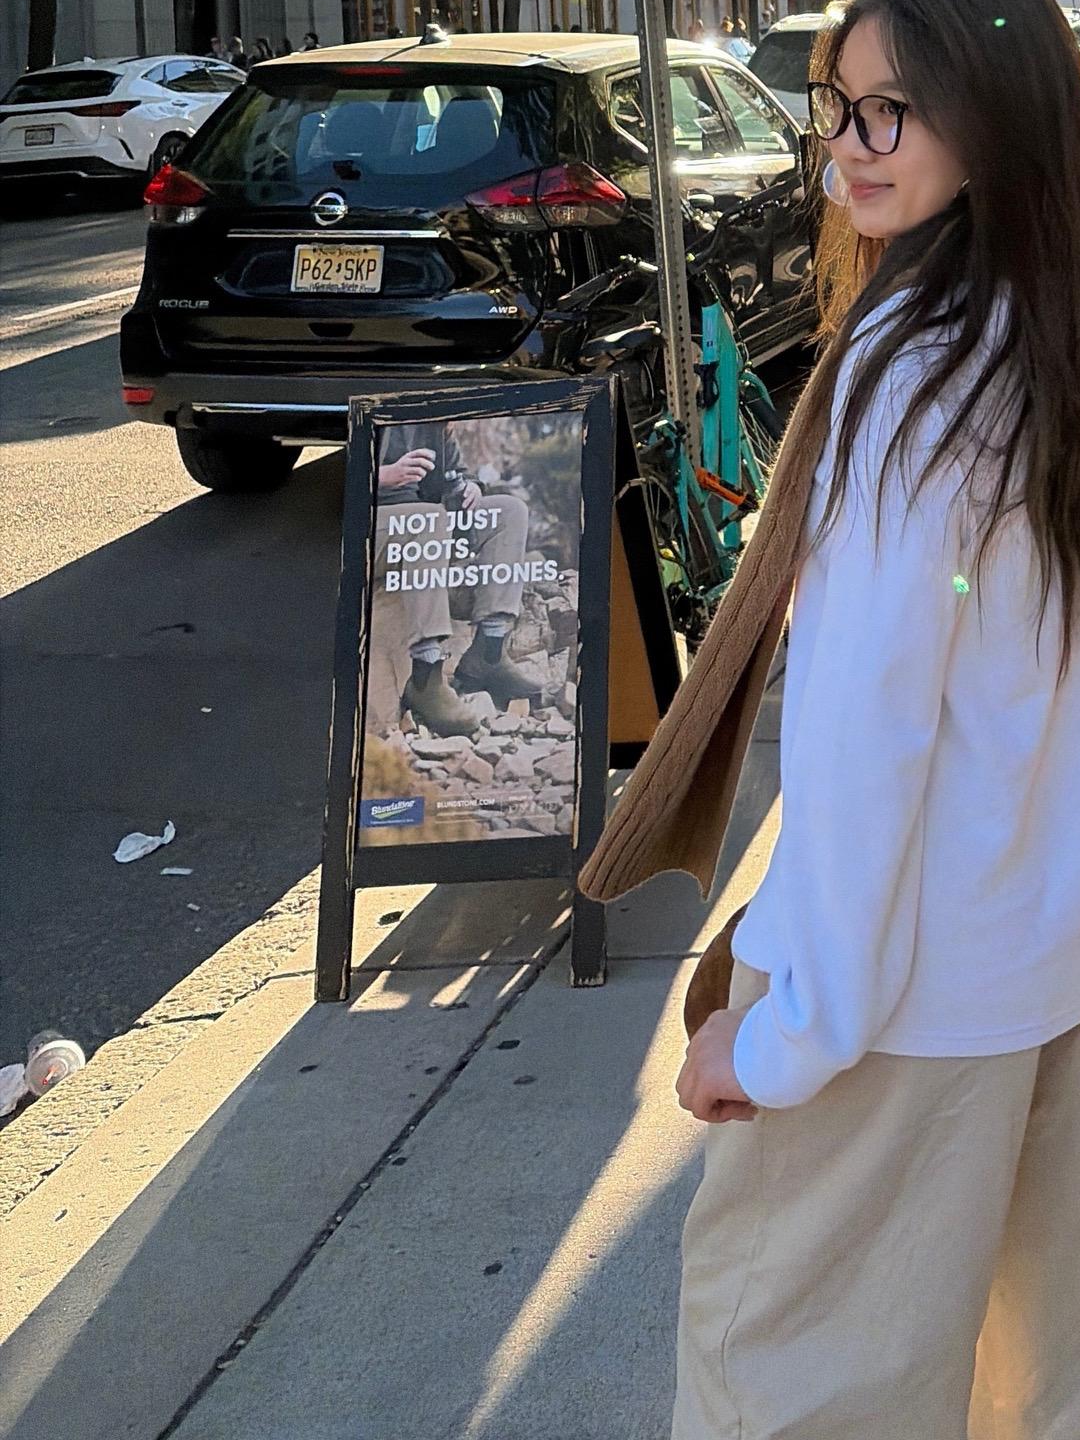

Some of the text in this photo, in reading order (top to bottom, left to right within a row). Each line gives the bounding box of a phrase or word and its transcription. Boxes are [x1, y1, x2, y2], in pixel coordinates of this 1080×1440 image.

[300, 258, 377, 281] P62 SKP
[488, 305, 518, 314] AWD
[388, 508, 502, 536] NOT JUST
[386, 537, 476, 564] BOOTS.
[385, 560, 565, 592] BLUNDSTONES.
